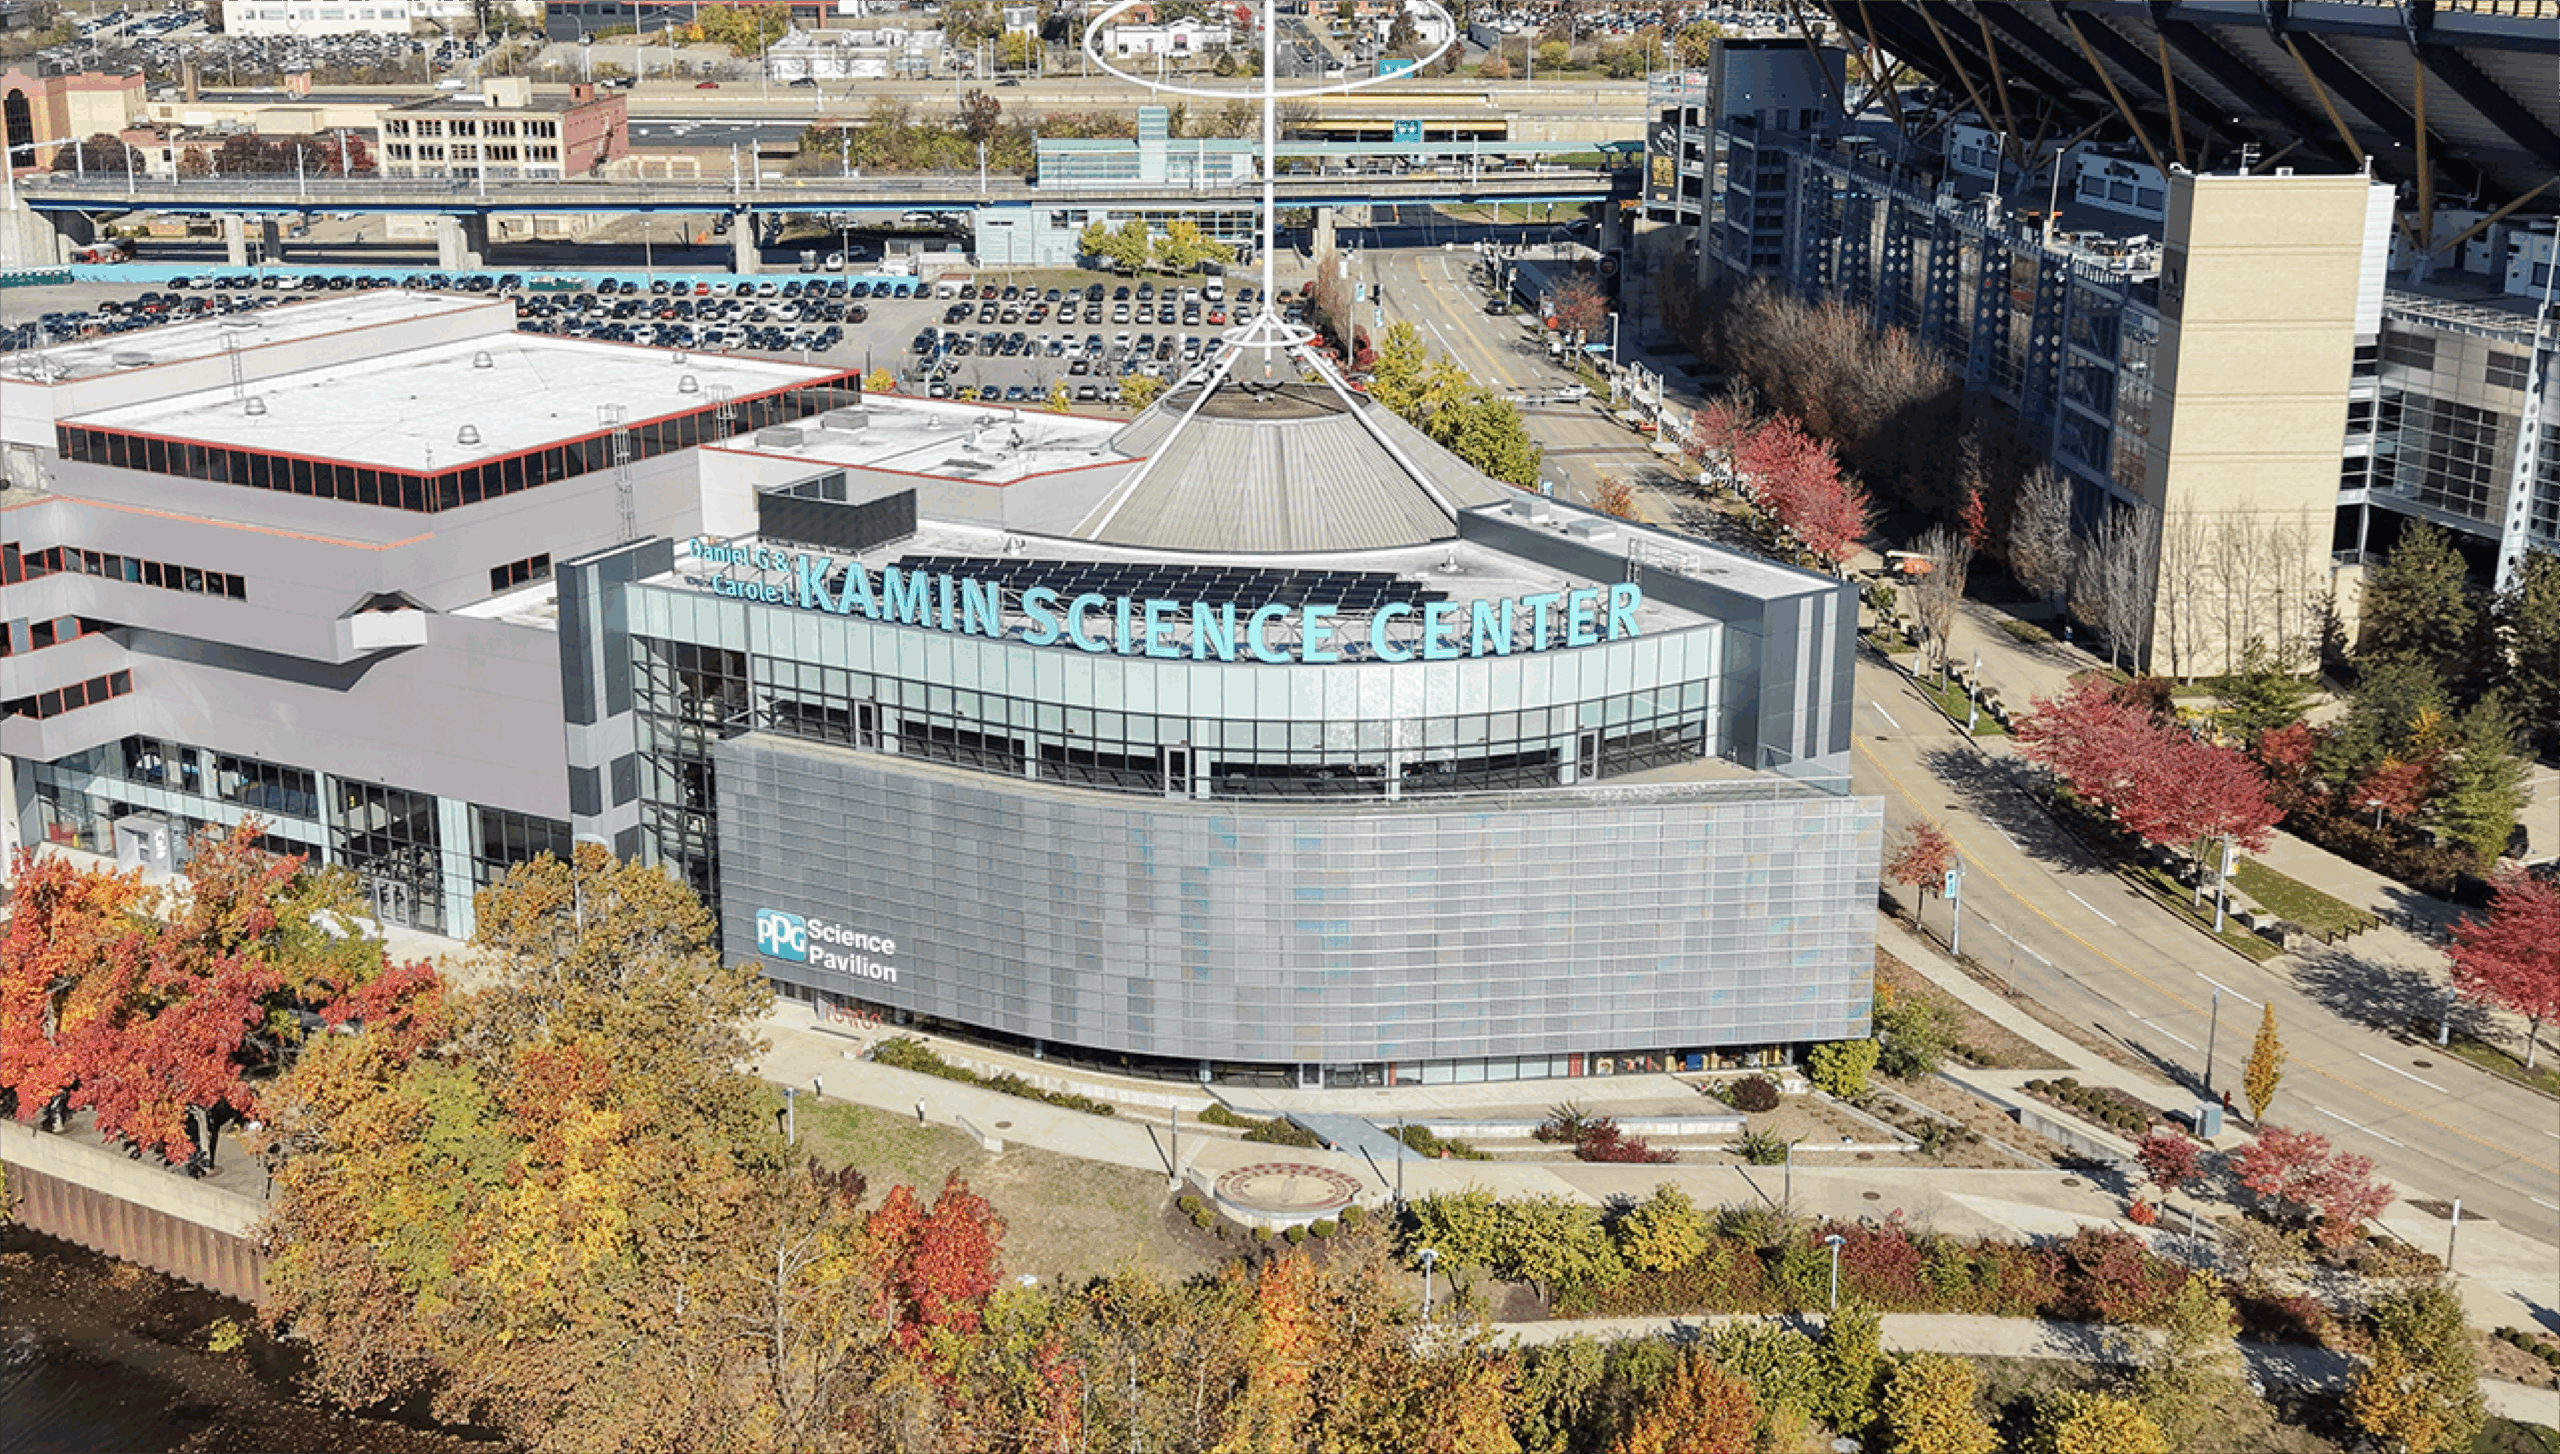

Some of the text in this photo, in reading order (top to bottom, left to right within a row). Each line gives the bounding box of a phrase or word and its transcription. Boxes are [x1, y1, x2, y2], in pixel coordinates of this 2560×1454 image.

[689, 538, 790, 572] Daniel G &
[713, 573, 777, 602] Carole
[799, 554, 1643, 663] KAMIN SCIENCE CENTER
[757, 913, 806, 955] PPG
[806, 918, 896, 955] Science
[809, 945, 898, 983] Pavilion
